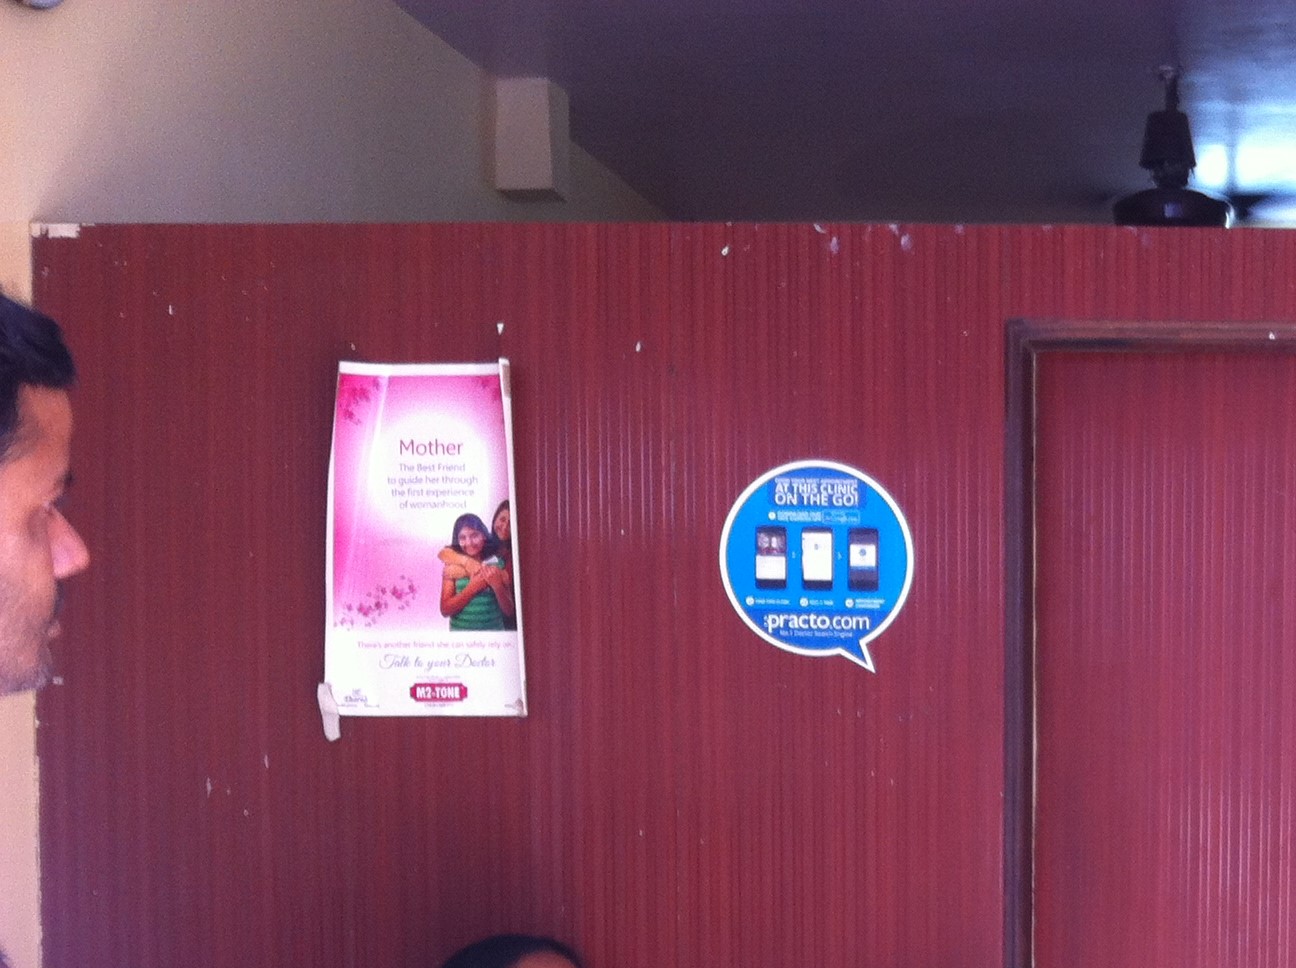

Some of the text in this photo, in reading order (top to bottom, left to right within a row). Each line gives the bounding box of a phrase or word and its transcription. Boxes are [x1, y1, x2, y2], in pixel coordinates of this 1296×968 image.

[399, 438, 463, 456] Mother
[399, 463, 465, 472] The Best Friend
[387, 475, 478, 486] to guide her through
[391, 487, 474, 498] the first experience
[775, 483, 858, 495] AT THIS CLINIC
[399, 500, 467, 509] of womanhood
[774, 493, 859, 507] ON THE GO!
[379, 653, 495, 673] Talk to your Doctor
